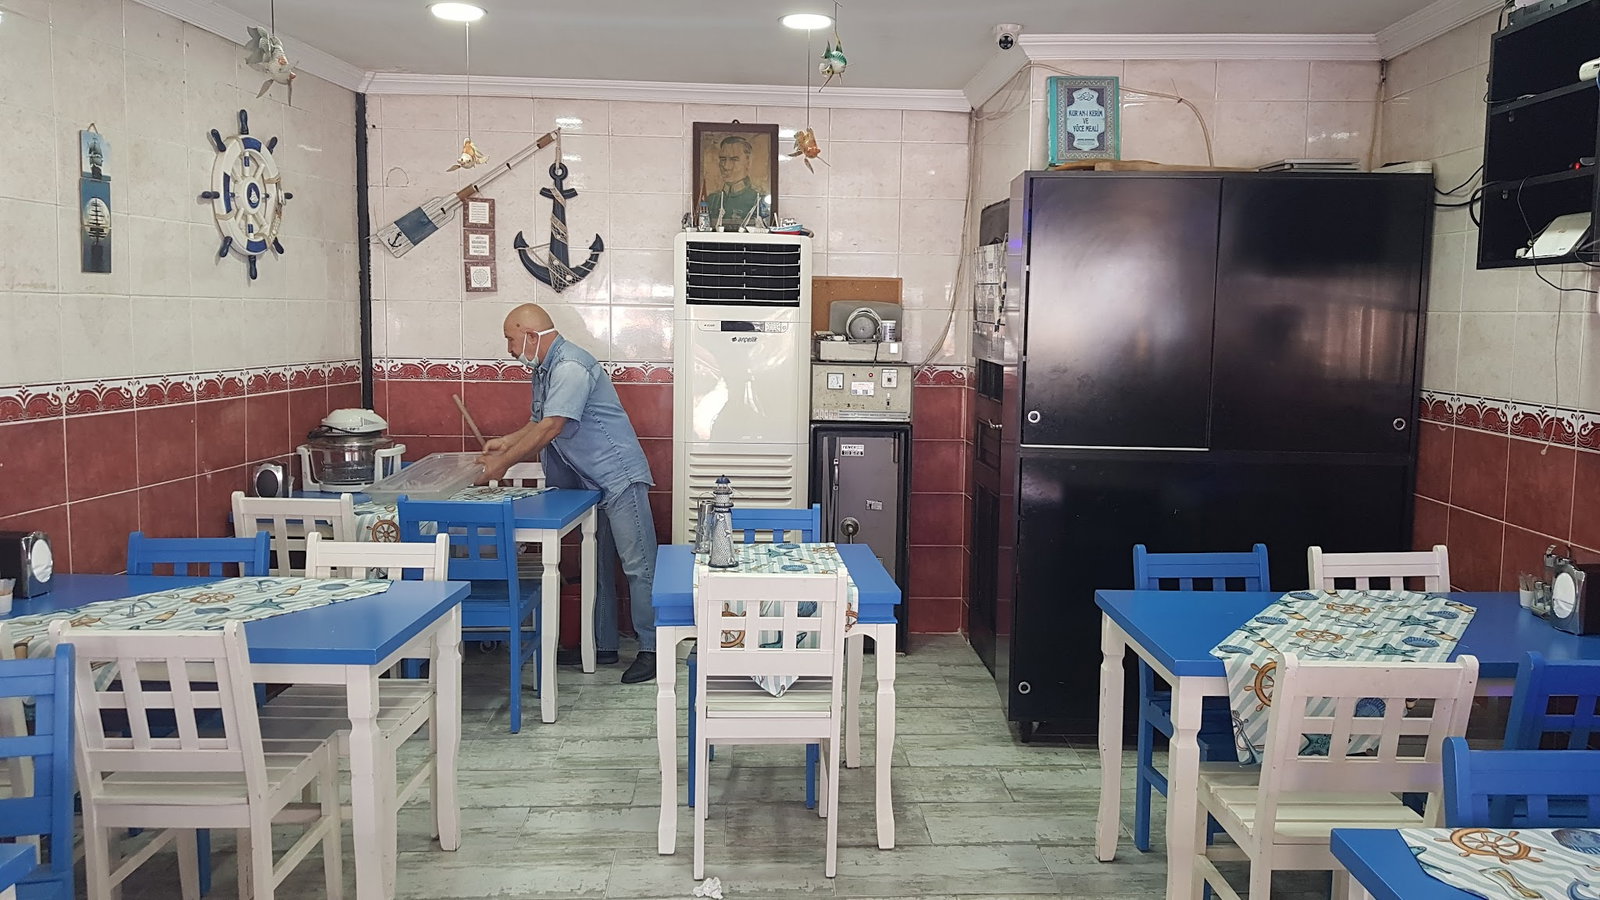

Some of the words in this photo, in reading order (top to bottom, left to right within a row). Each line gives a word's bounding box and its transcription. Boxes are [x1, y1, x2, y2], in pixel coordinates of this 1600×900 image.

[1089, 108, 1103, 117] KERİM
[1073, 124, 1085, 132] YÜCE
[1085, 124, 1099, 132] MEALİ
